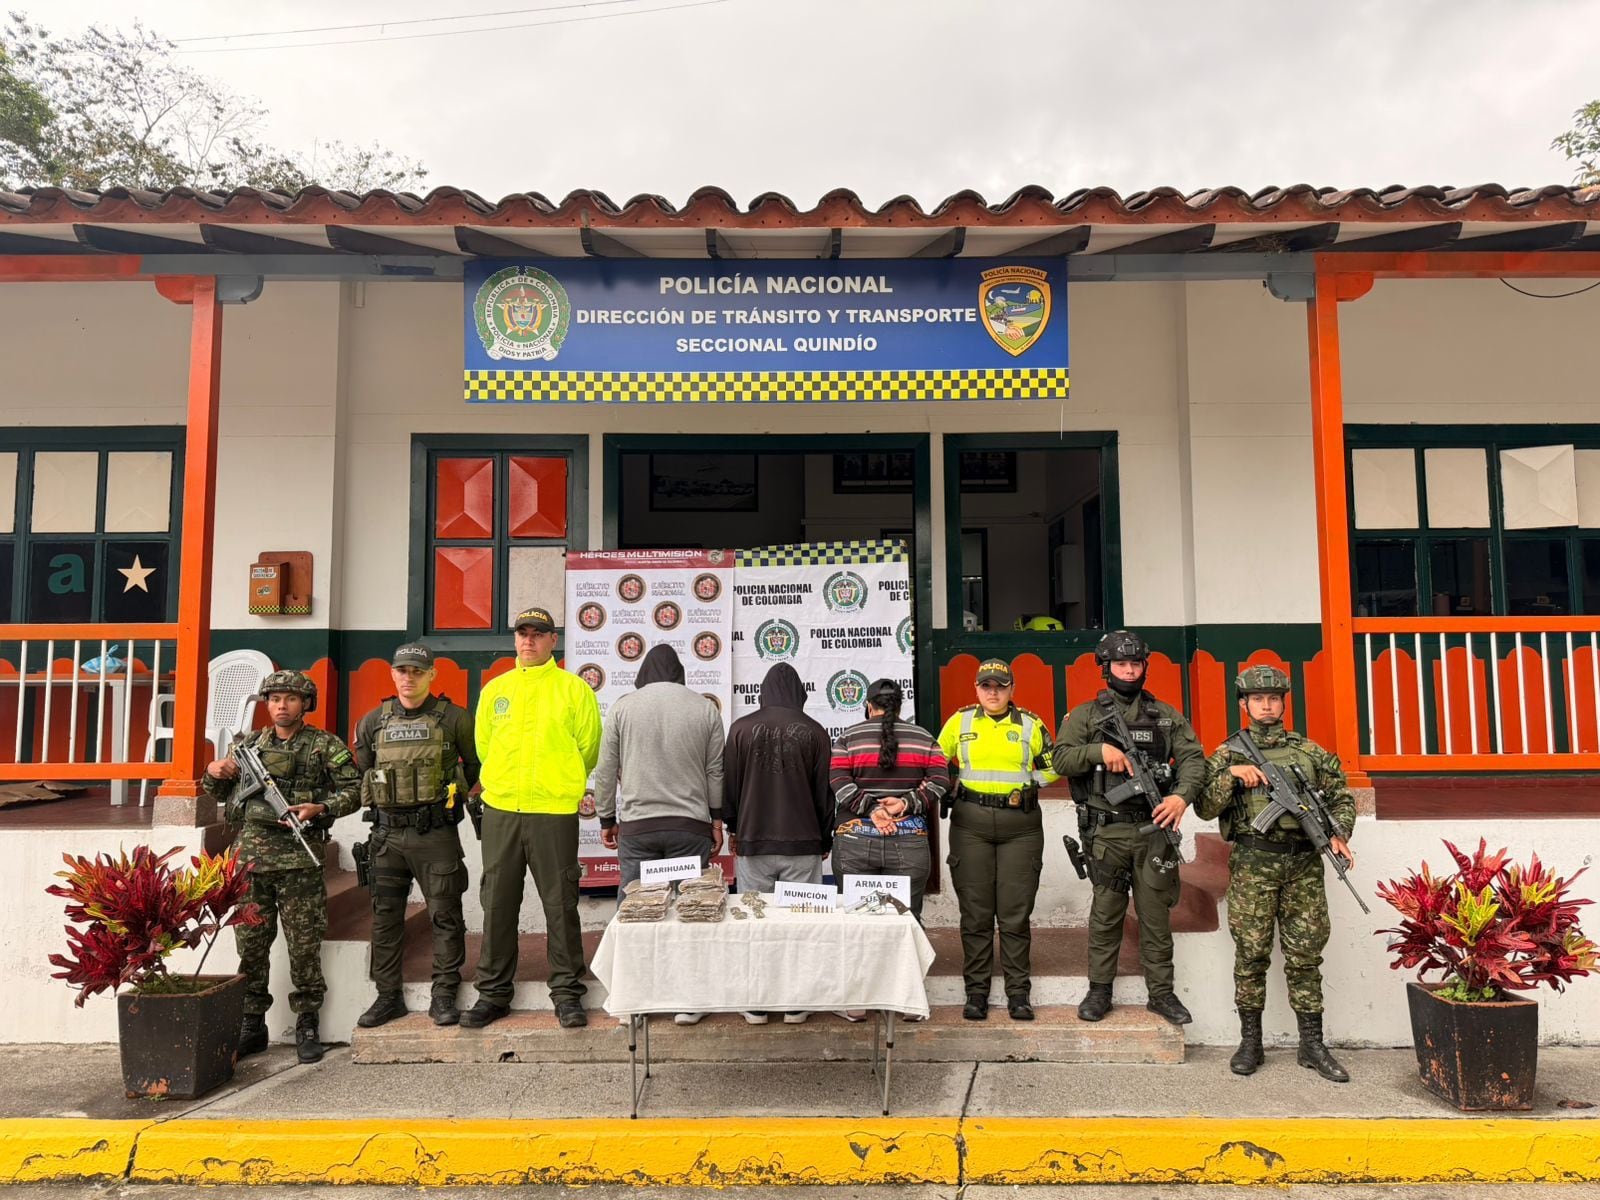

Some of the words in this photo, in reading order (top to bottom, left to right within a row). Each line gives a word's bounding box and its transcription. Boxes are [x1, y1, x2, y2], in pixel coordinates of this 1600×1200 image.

[659, 273, 758, 294] POLICÍA
[766, 276, 893, 294] NACIONAL
[535, 281, 558, 318] COLOMBIA
[576, 308, 684, 325] DIRECCIÓN
[691, 310, 717, 324] DE
[722, 307, 821, 324] TRÁNSITO
[827, 309, 840, 324] Y
[846, 308, 976, 323] TRANSPORTE
[522, 327, 555, 349] NACIONAL
[676, 338, 788, 352] SECCIONAL
[794, 334, 878, 352] QUINDÍO
[522, 347, 547, 358] PATRIA
[48, 553, 86, 594] a
[768, 584, 812, 594] NACIONAL
[878, 580, 908, 591] POLICI
[742, 596, 754, 606] DE
[755, 594, 802, 606] COLOMBIA
[890, 592, 902, 602] DE
[810, 628, 846, 638] POLICIA
[848, 626, 892, 638] NACIONAL
[822, 640, 832, 650] DE
[834, 638, 882, 649] COLOMBIA
[744, 695, 756, 705] DE
[390, 730, 422, 740] GAMA
[646, 864, 696, 874] MARIHUANA
[855, 880, 882, 888] ARMA
[784, 890, 828, 900] MUNICIÓN
